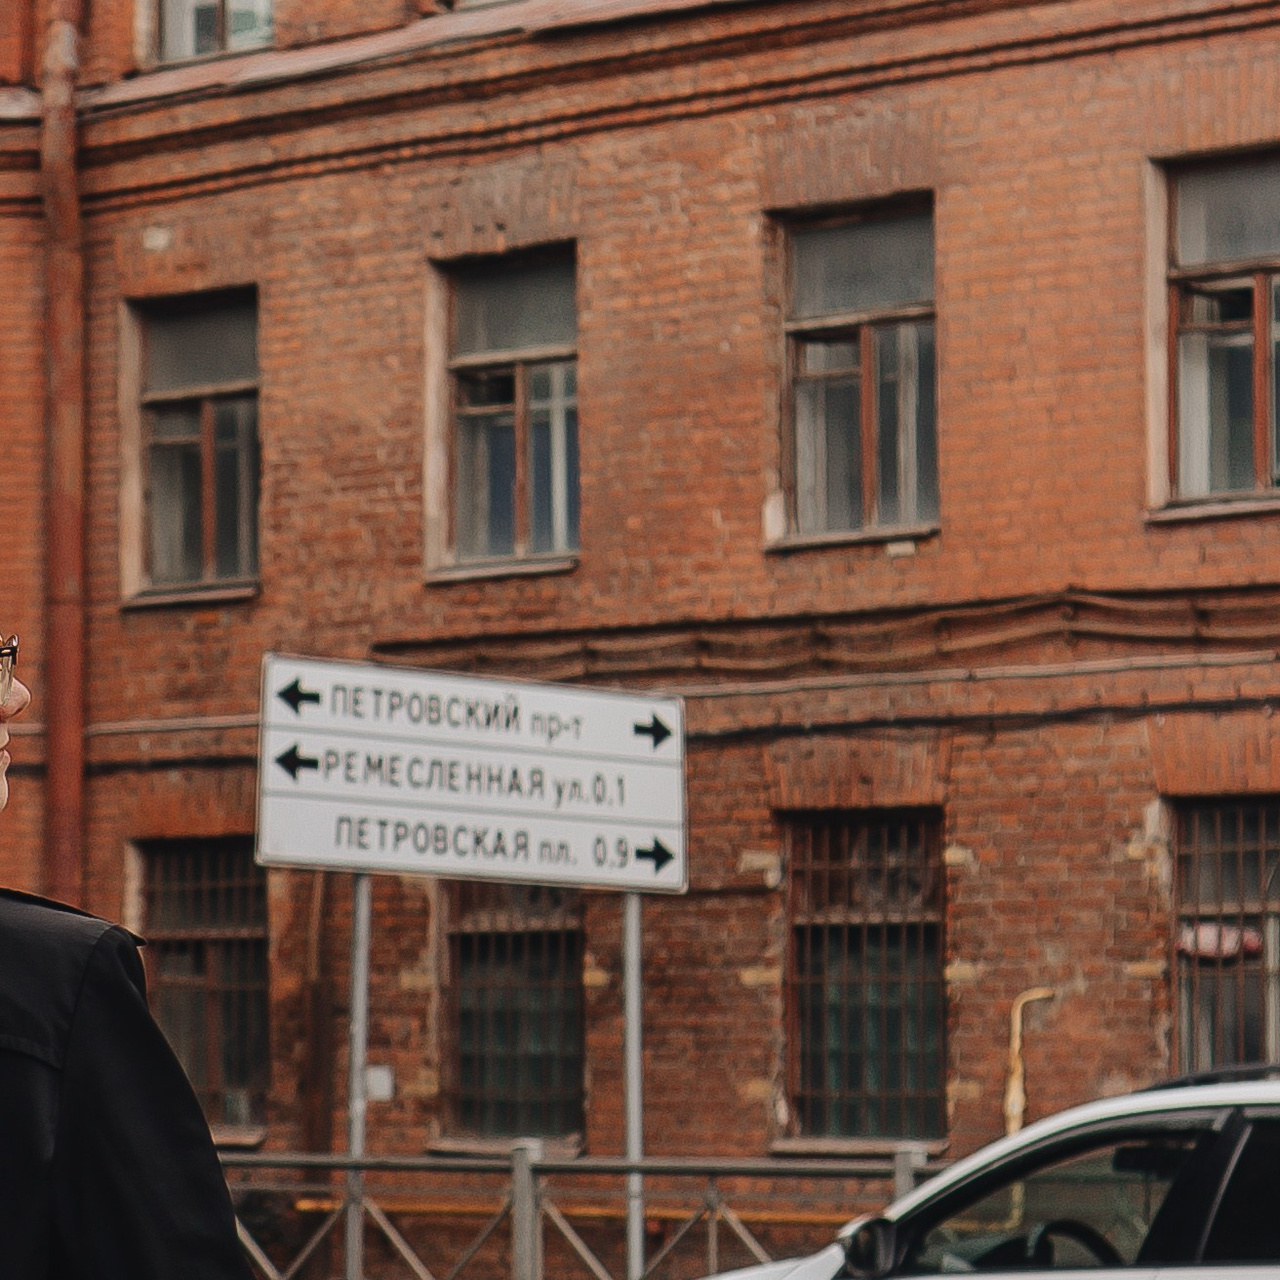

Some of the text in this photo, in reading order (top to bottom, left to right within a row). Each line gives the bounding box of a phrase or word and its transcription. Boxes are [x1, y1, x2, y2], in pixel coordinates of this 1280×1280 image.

[331, 684, 583, 744] ПЕТРОВСКИЙ пр-т
[324, 749, 545, 797] РЕМЕСЛЕННАЯ
[335, 816, 530, 861] ПЕТРОВСКАЯ
[593, 837, 629, 868] 0.9
